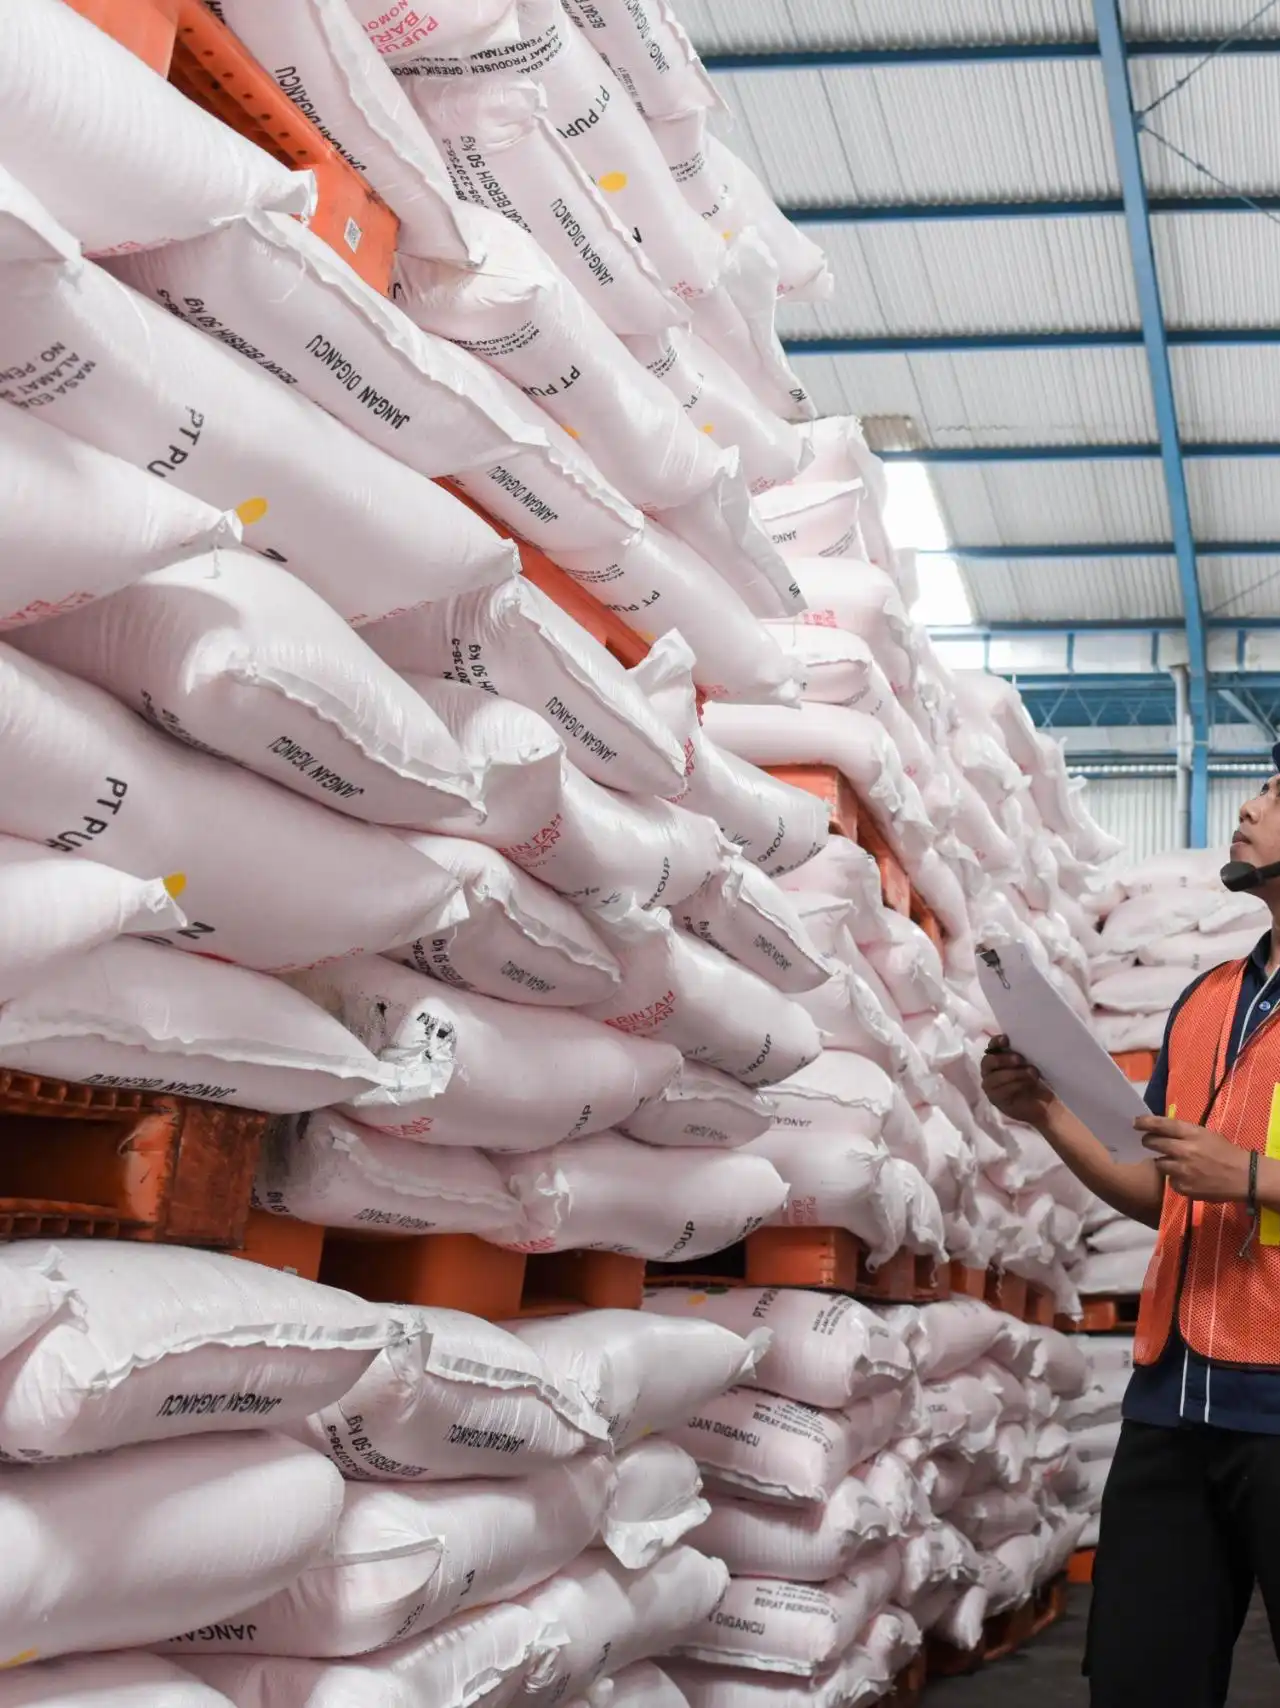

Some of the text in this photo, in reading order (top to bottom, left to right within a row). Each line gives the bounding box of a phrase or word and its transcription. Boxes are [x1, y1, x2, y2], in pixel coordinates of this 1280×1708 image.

[365, 0, 409, 32] NOMO
[377, 15, 438, 54] PUPU
[466, 153, 486, 169] 50
[550, 198, 615, 287] JANGAN DIGANCU
[197, 314, 224, 331] 50
[17, 352, 80, 394] ALAMAT
[52, 360, 97, 395] MASA
[305, 333, 411, 430] JANGAN DIGANCU
[486, 464, 560, 524] JANGAN DIGANCU
[467, 643, 483, 661] kg
[470, 662, 488, 682] 50
[545, 695, 619, 765] JANGAN DIGANCU
[96, 775, 129, 815] PT
[308, 764, 366, 801] JANGAN
[157, 1391, 283, 1418] JANGAN DIGANCU
[346, 1413, 362, 1434] kg
[448, 1422, 526, 1456] JANGAN DIGANCU
[713, 1418, 761, 1448] DIGANCU
[350, 1435, 374, 1456] 50
[714, 1610, 766, 1636] DIGANCU
